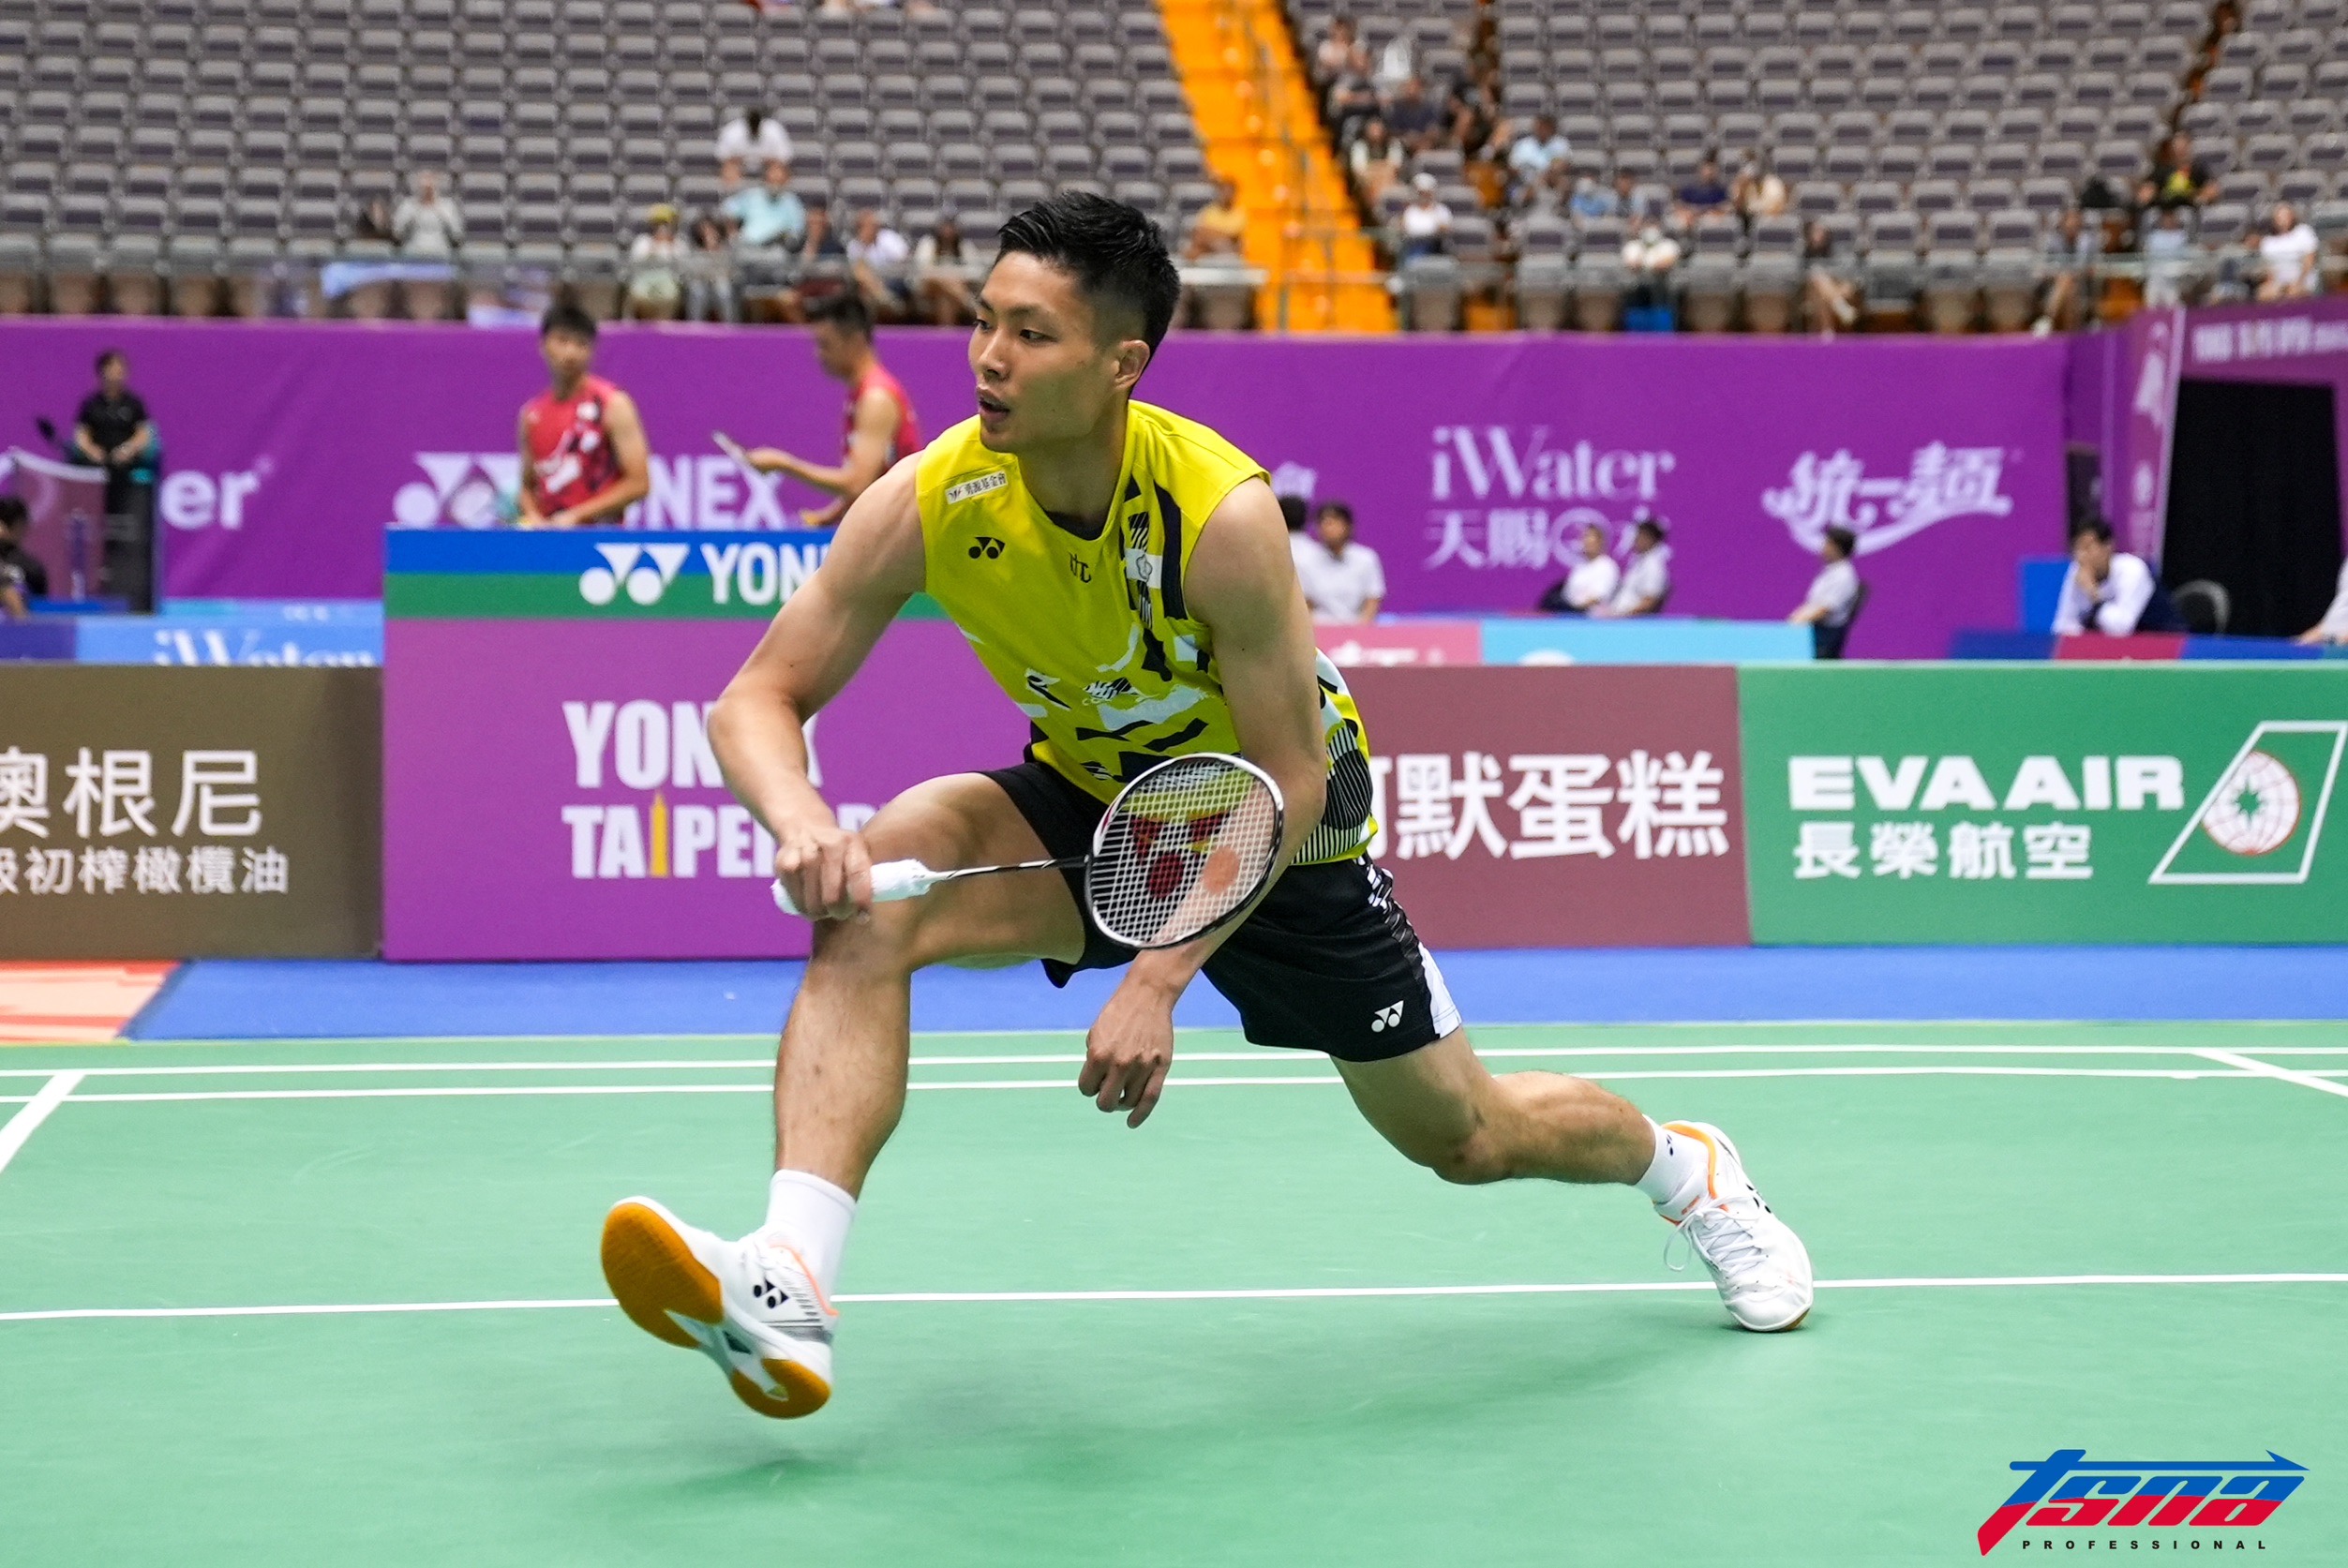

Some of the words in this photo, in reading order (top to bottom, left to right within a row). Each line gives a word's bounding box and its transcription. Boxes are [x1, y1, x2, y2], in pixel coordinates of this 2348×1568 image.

[622, 455, 787, 530] NEX
[1430, 426, 1676, 500] iWater
[700, 542, 830, 605] YON
[1793, 820, 2094, 880] 長榮航空
